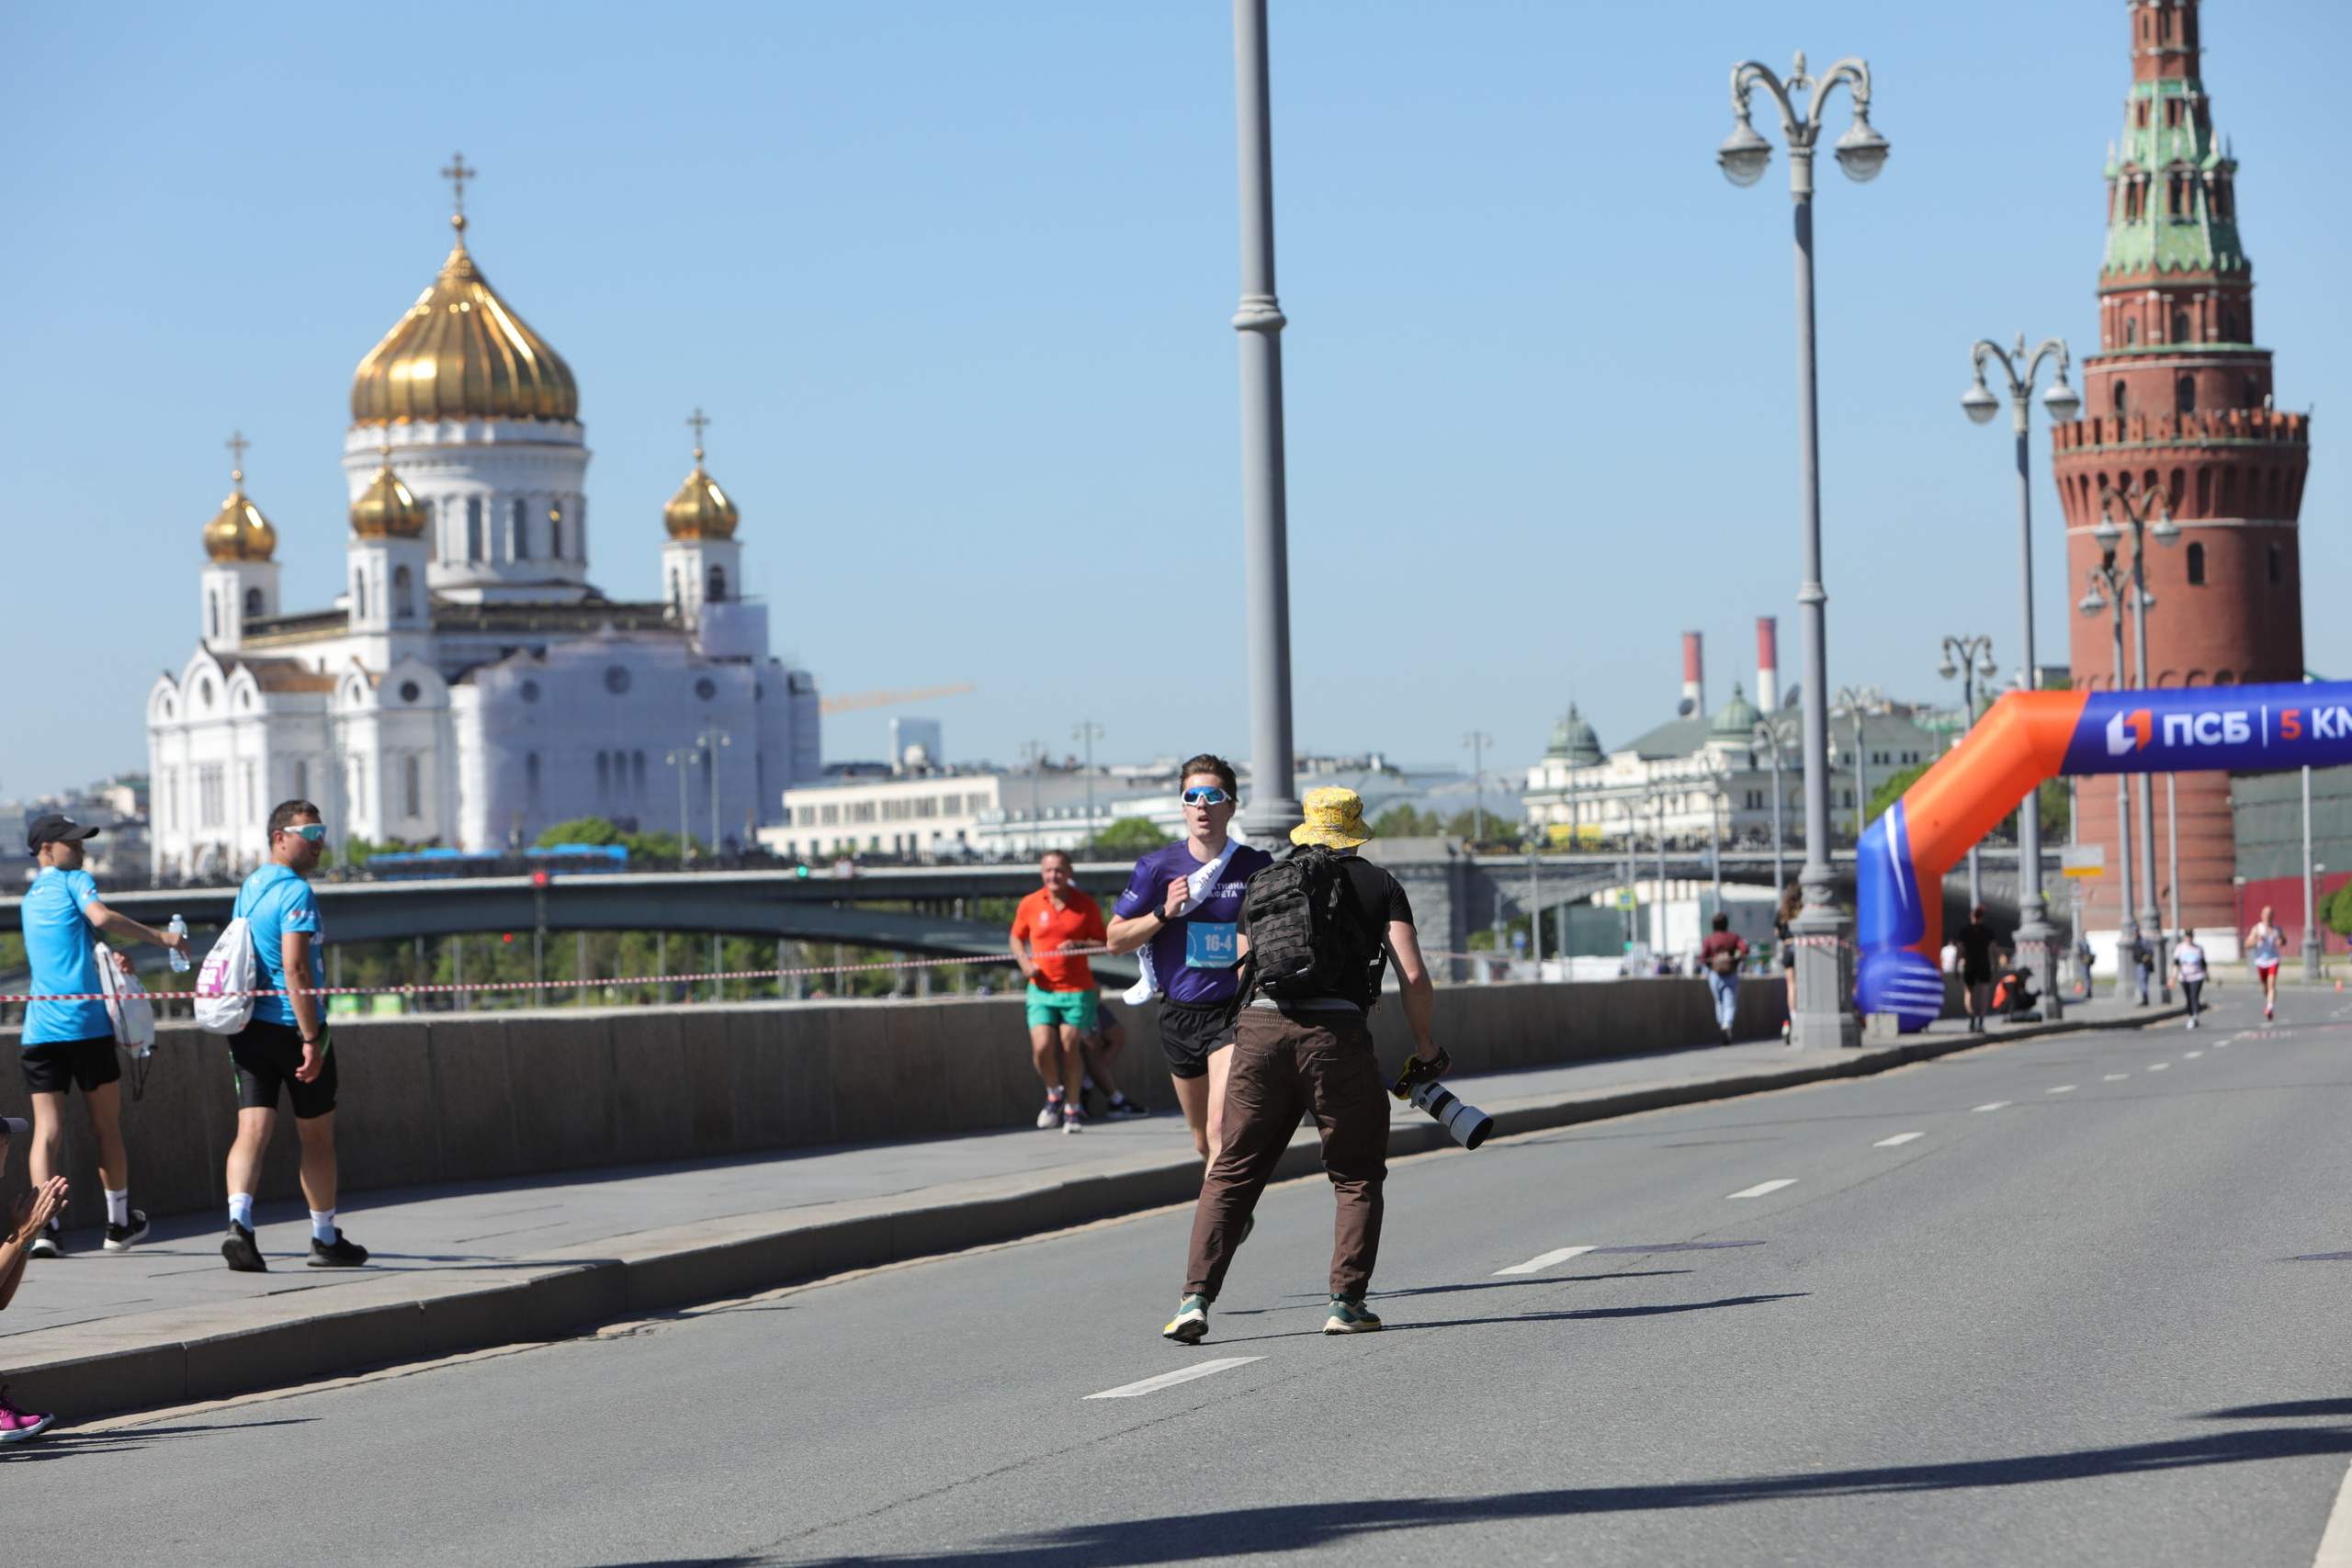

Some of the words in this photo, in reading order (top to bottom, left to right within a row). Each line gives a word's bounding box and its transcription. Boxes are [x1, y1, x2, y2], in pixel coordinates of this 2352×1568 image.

[2163, 710, 2251, 747] ПСБ
[2280, 709, 2301, 740] 5
[1204, 934, 1232, 952] 16-4
